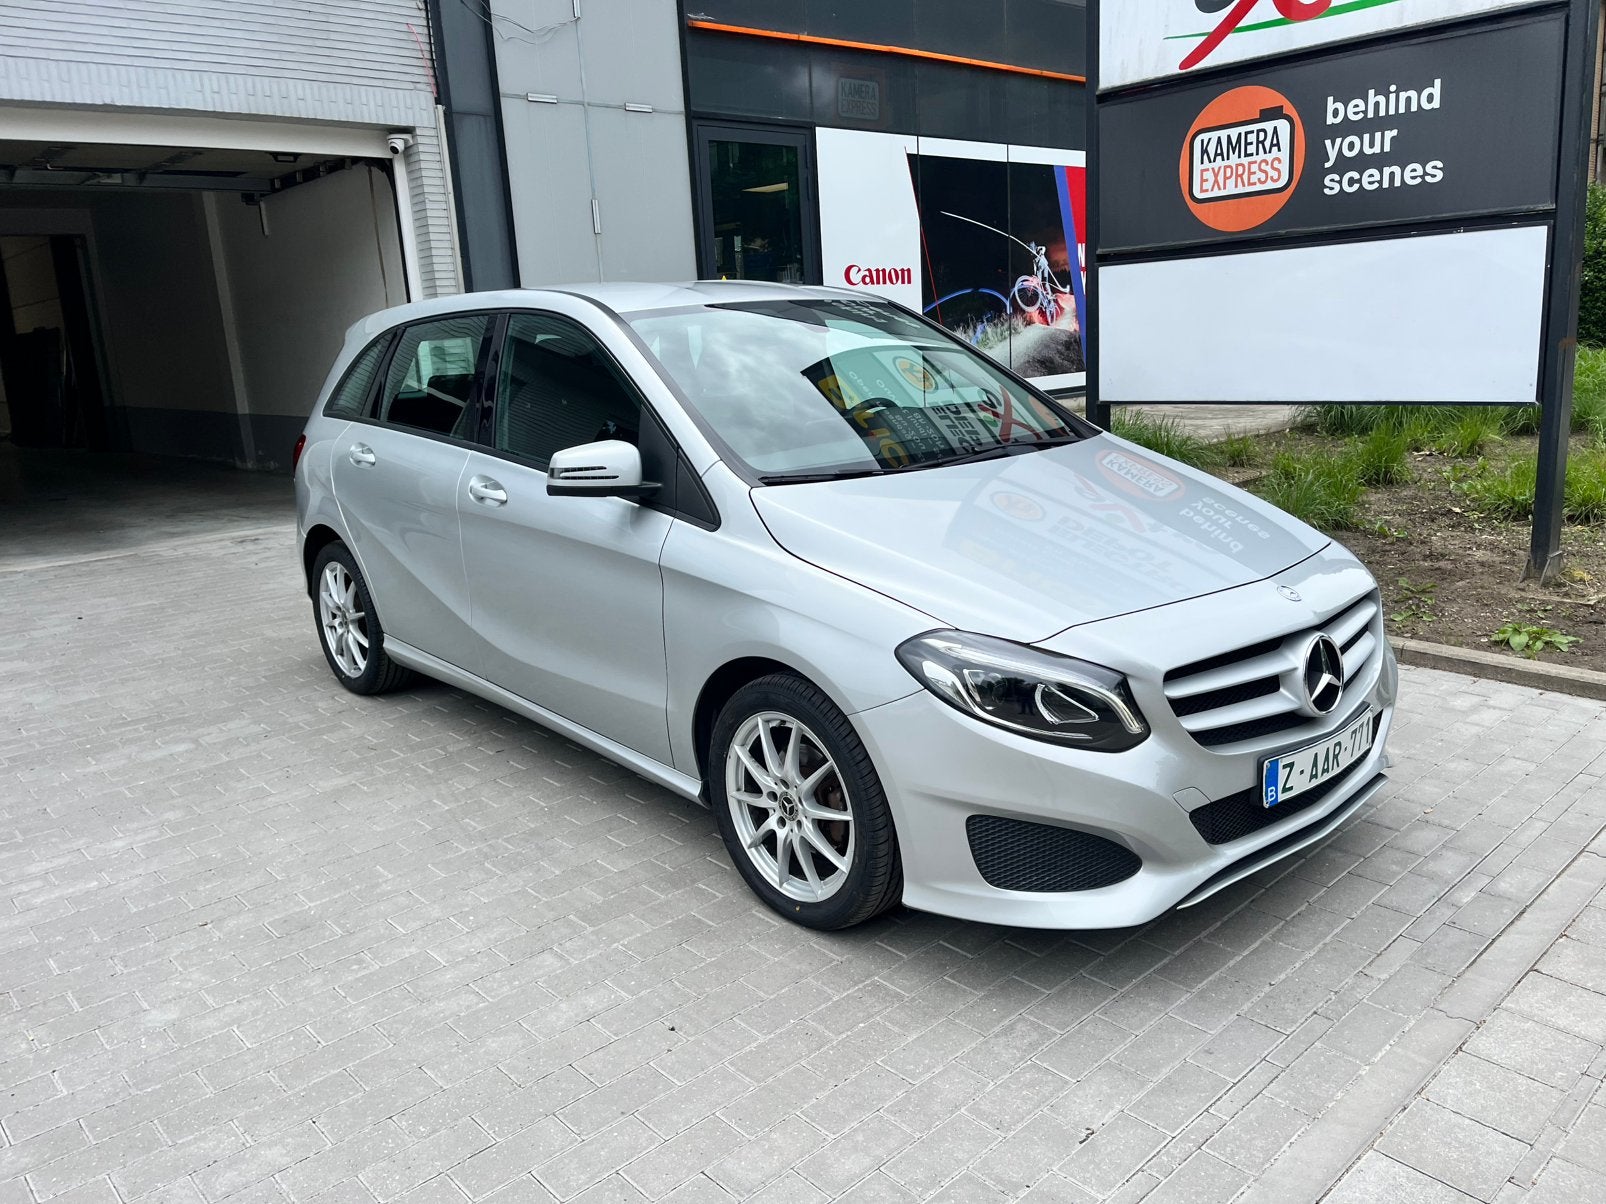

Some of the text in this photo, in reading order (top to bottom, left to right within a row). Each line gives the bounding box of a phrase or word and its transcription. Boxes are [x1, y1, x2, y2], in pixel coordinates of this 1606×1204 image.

[840, 80, 877, 100] KAMERA
[1326, 78, 1442, 125] behind
[1200, 125, 1282, 165] KAMERA
[1324, 128, 1398, 168] your
[1200, 156, 1282, 194] EXPRESS
[1323, 160, 1444, 195] scenes
[844, 264, 912, 286] Canon
[1281, 716, 1372, 795] Z-AAR-771
[1267, 786, 1277, 802] B
